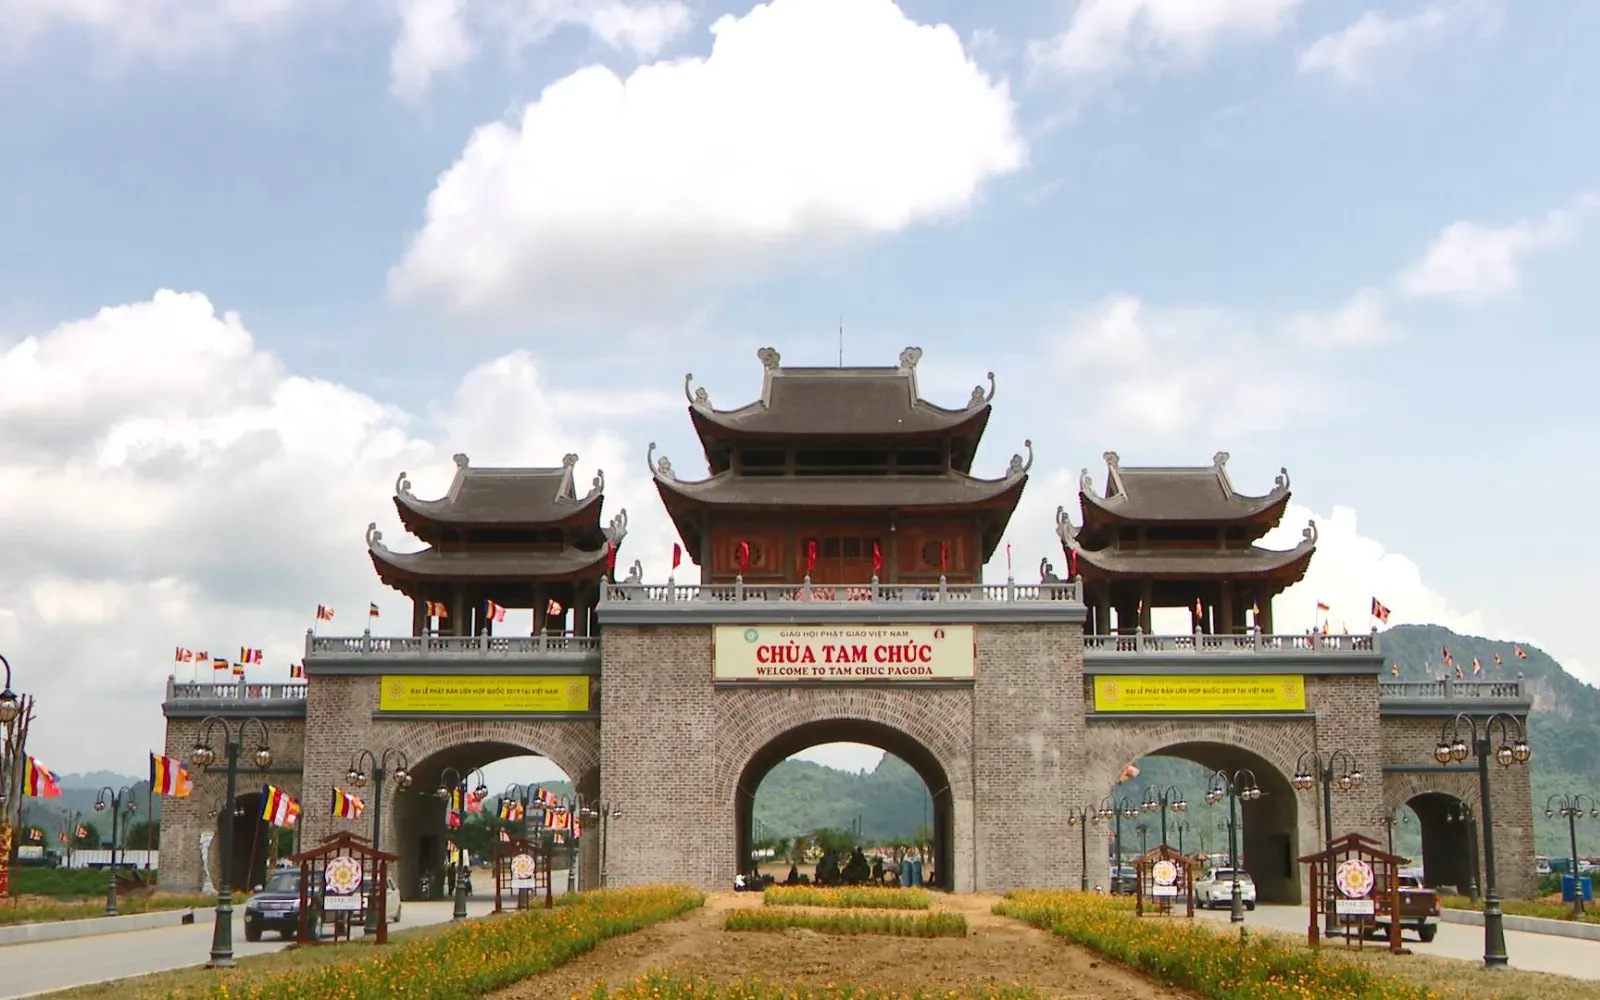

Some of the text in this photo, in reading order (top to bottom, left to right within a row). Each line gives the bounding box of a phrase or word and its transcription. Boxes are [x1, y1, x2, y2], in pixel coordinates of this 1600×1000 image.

[780, 630, 801, 638] GIÁO
[803, 630, 819, 638] HỘI
[820, 629, 843, 638] PHẬT
[846, 629, 868, 638] GIÁO
[869, 629, 888, 638] VIỆT
[756, 639, 932, 663] CHÙA TAM CHÚC
[756, 666, 933, 675] WELCOME TO TAM CHUC PAGODA
